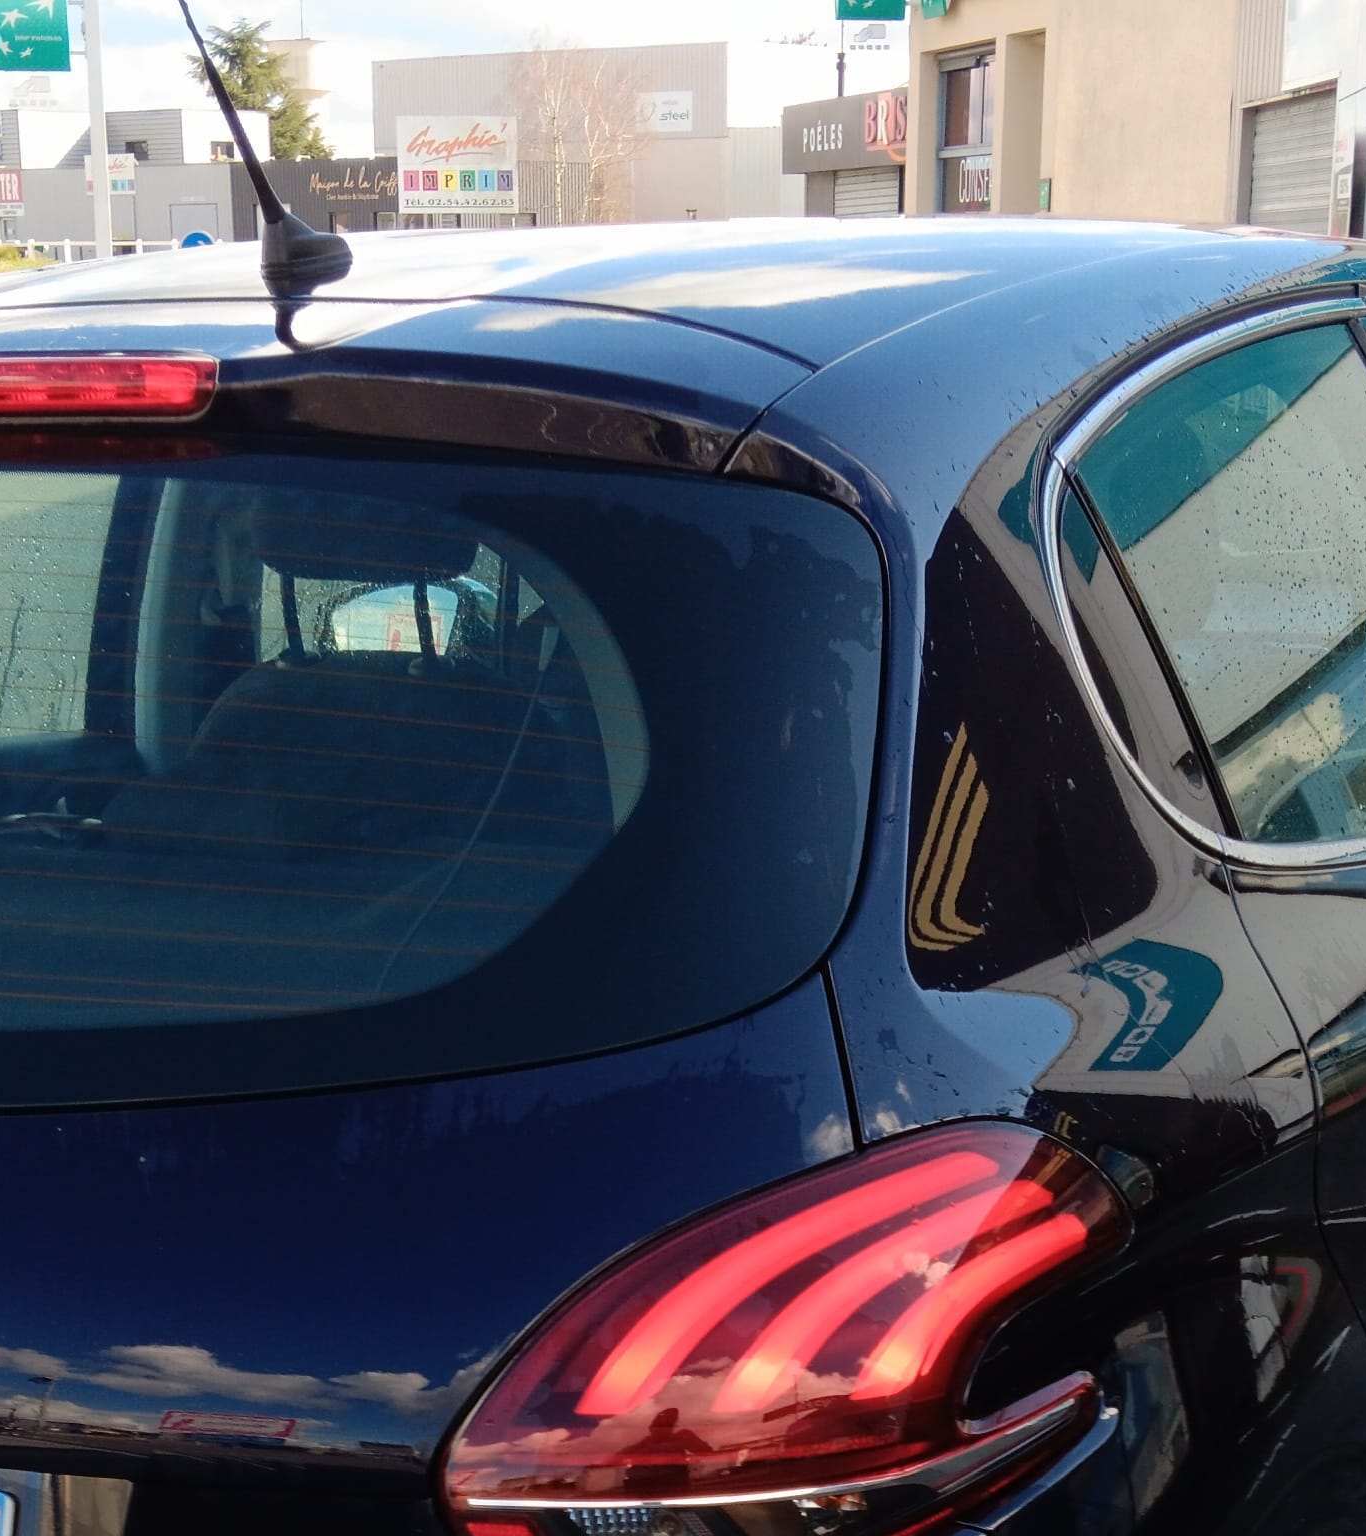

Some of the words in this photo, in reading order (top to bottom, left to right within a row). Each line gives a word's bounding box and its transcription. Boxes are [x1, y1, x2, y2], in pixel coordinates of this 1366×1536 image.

[659, 107, 690, 121] steel
[864, 95, 907, 145] BRIS
[374, 170, 398, 196] Coiff
[406, 171, 512, 190] IMPRIM
[958, 157, 993, 203] CONSE
